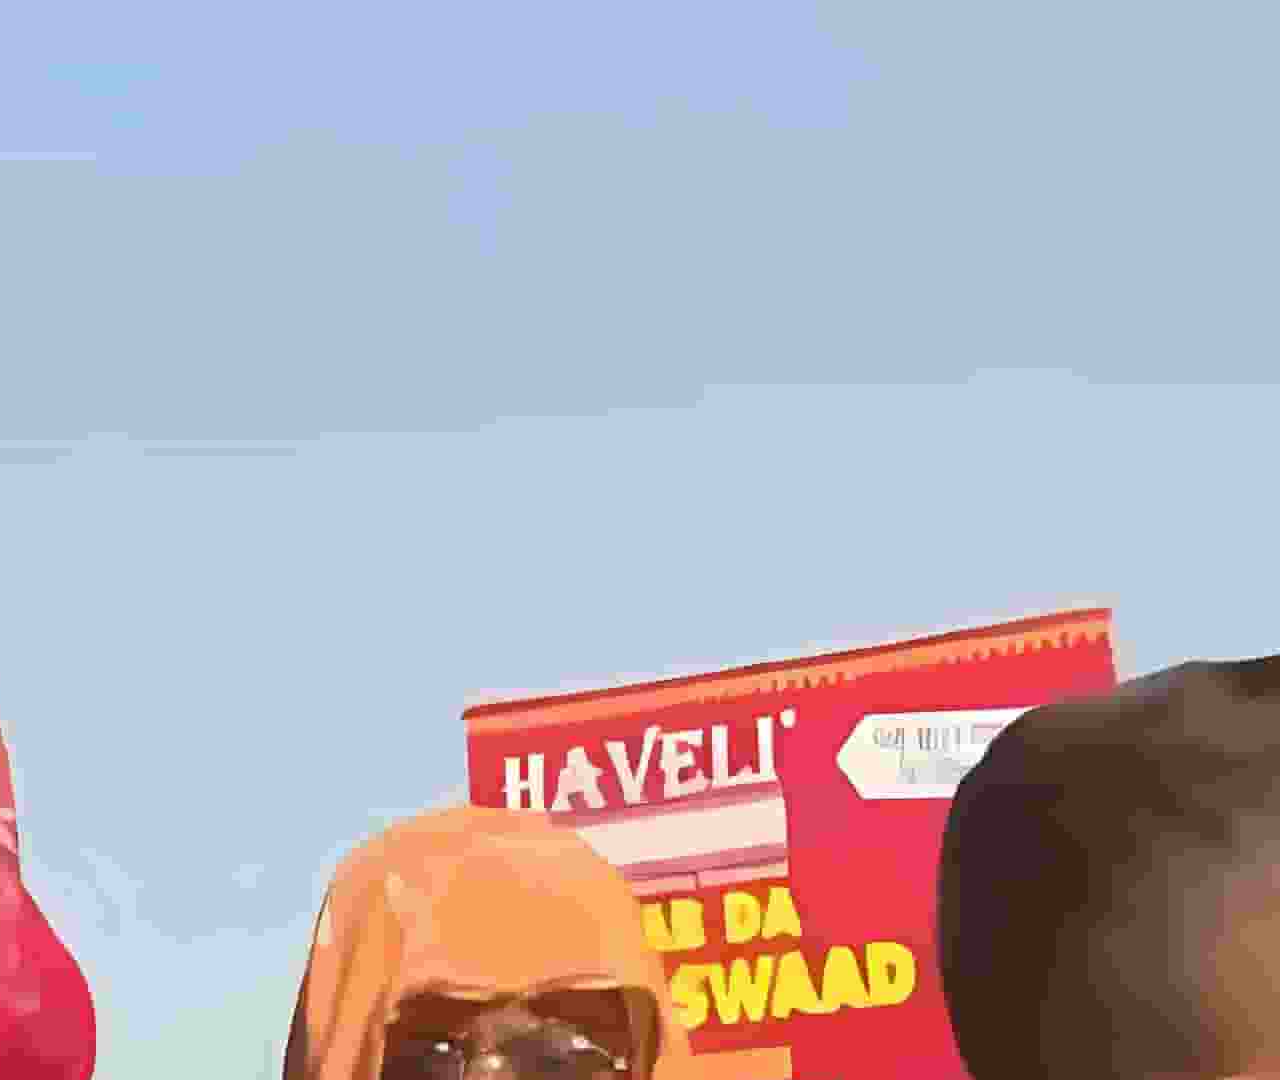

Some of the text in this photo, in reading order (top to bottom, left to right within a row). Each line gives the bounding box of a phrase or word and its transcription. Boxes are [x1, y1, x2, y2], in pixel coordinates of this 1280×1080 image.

[501, 713, 777, 812] HAVELI
[722, 887, 801, 944] DA
[671, 941, 916, 1030] SWAAD
